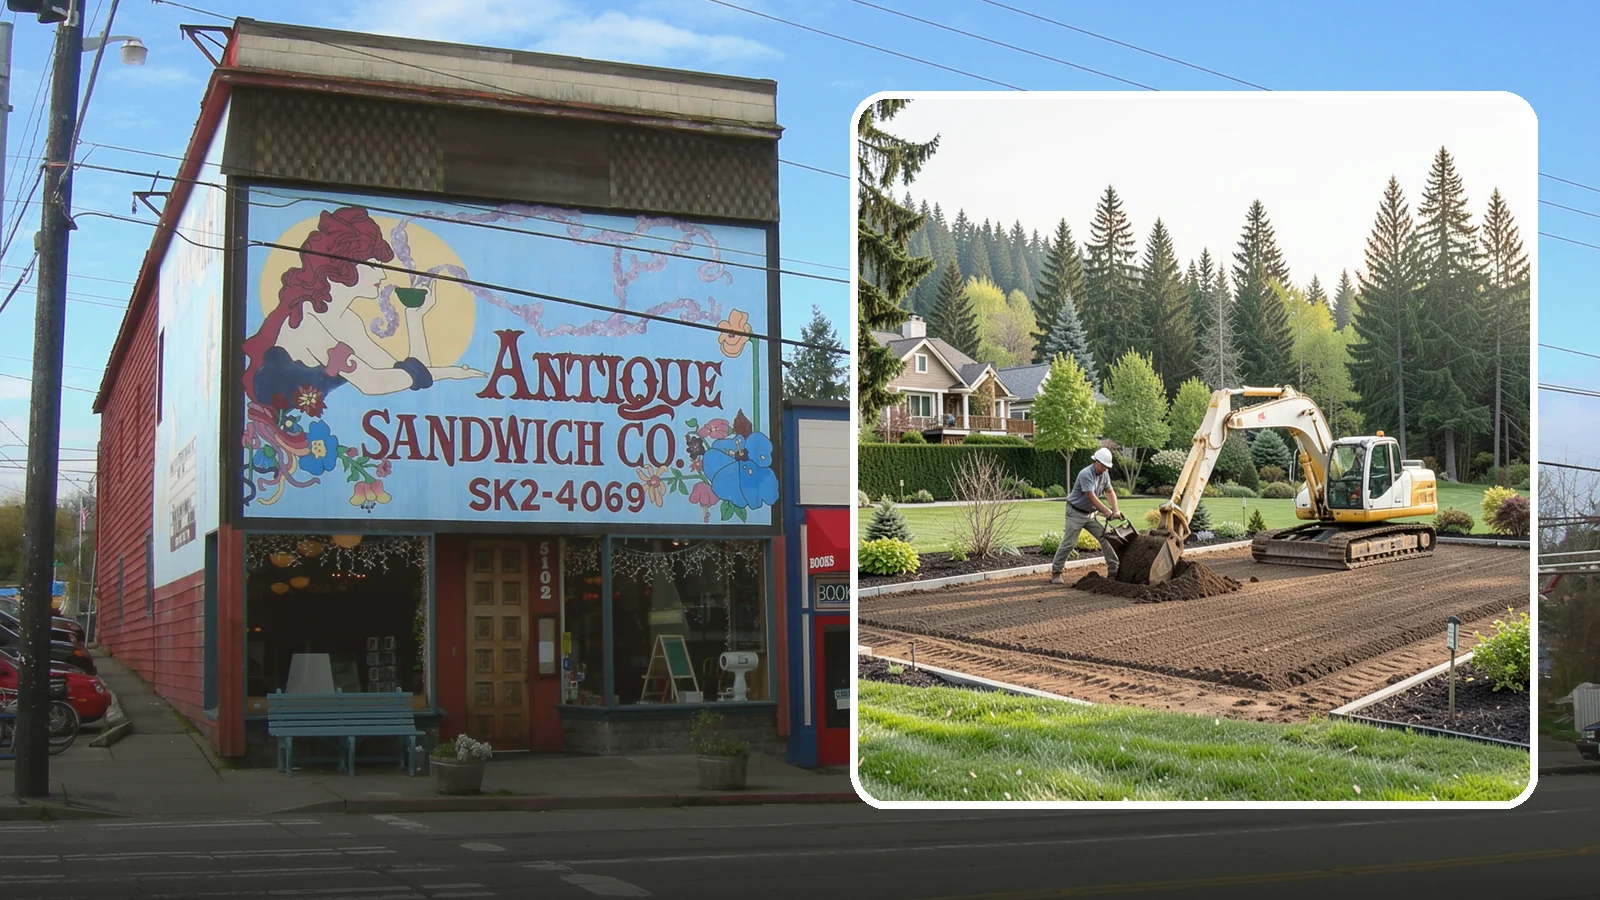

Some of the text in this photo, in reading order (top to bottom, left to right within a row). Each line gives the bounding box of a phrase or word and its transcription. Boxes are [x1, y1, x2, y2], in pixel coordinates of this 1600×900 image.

[476, 329, 723, 420] ANTIQUE
[361, 409, 685, 468] SANDWICH CO.
[468, 477, 645, 513] SK2-4069
[540, 542, 552, 600] 5102
[809, 555, 835, 569] BOOKS
